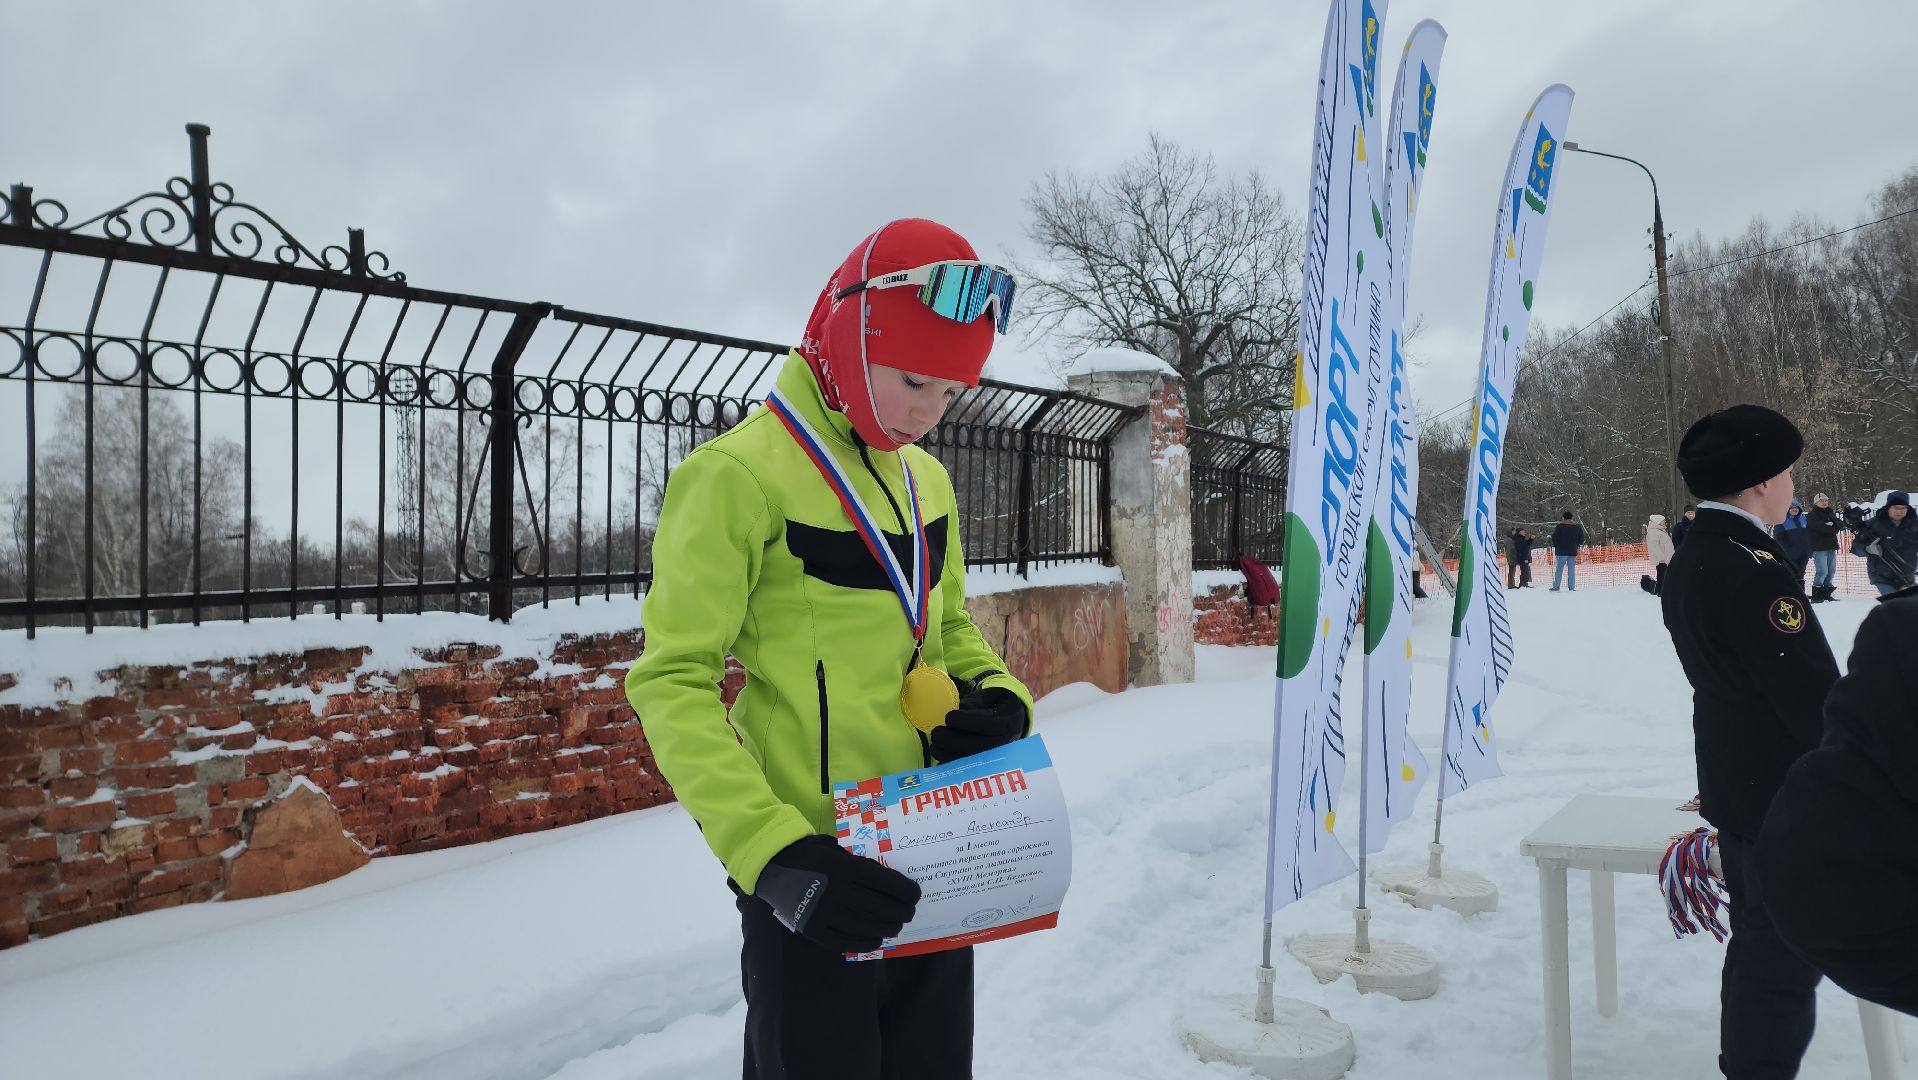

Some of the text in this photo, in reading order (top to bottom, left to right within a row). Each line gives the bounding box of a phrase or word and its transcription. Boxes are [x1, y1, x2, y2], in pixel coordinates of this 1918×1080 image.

[1368, 281, 1381, 384] СТУПИНО
[1321, 296, 1360, 567] СПОРТ
[1475, 363, 1509, 547] СПОРТ
[900, 768, 1028, 816] ГРАМОТА
[966, 810, 1032, 834] Александр
[972, 839, 1000, 852] место
